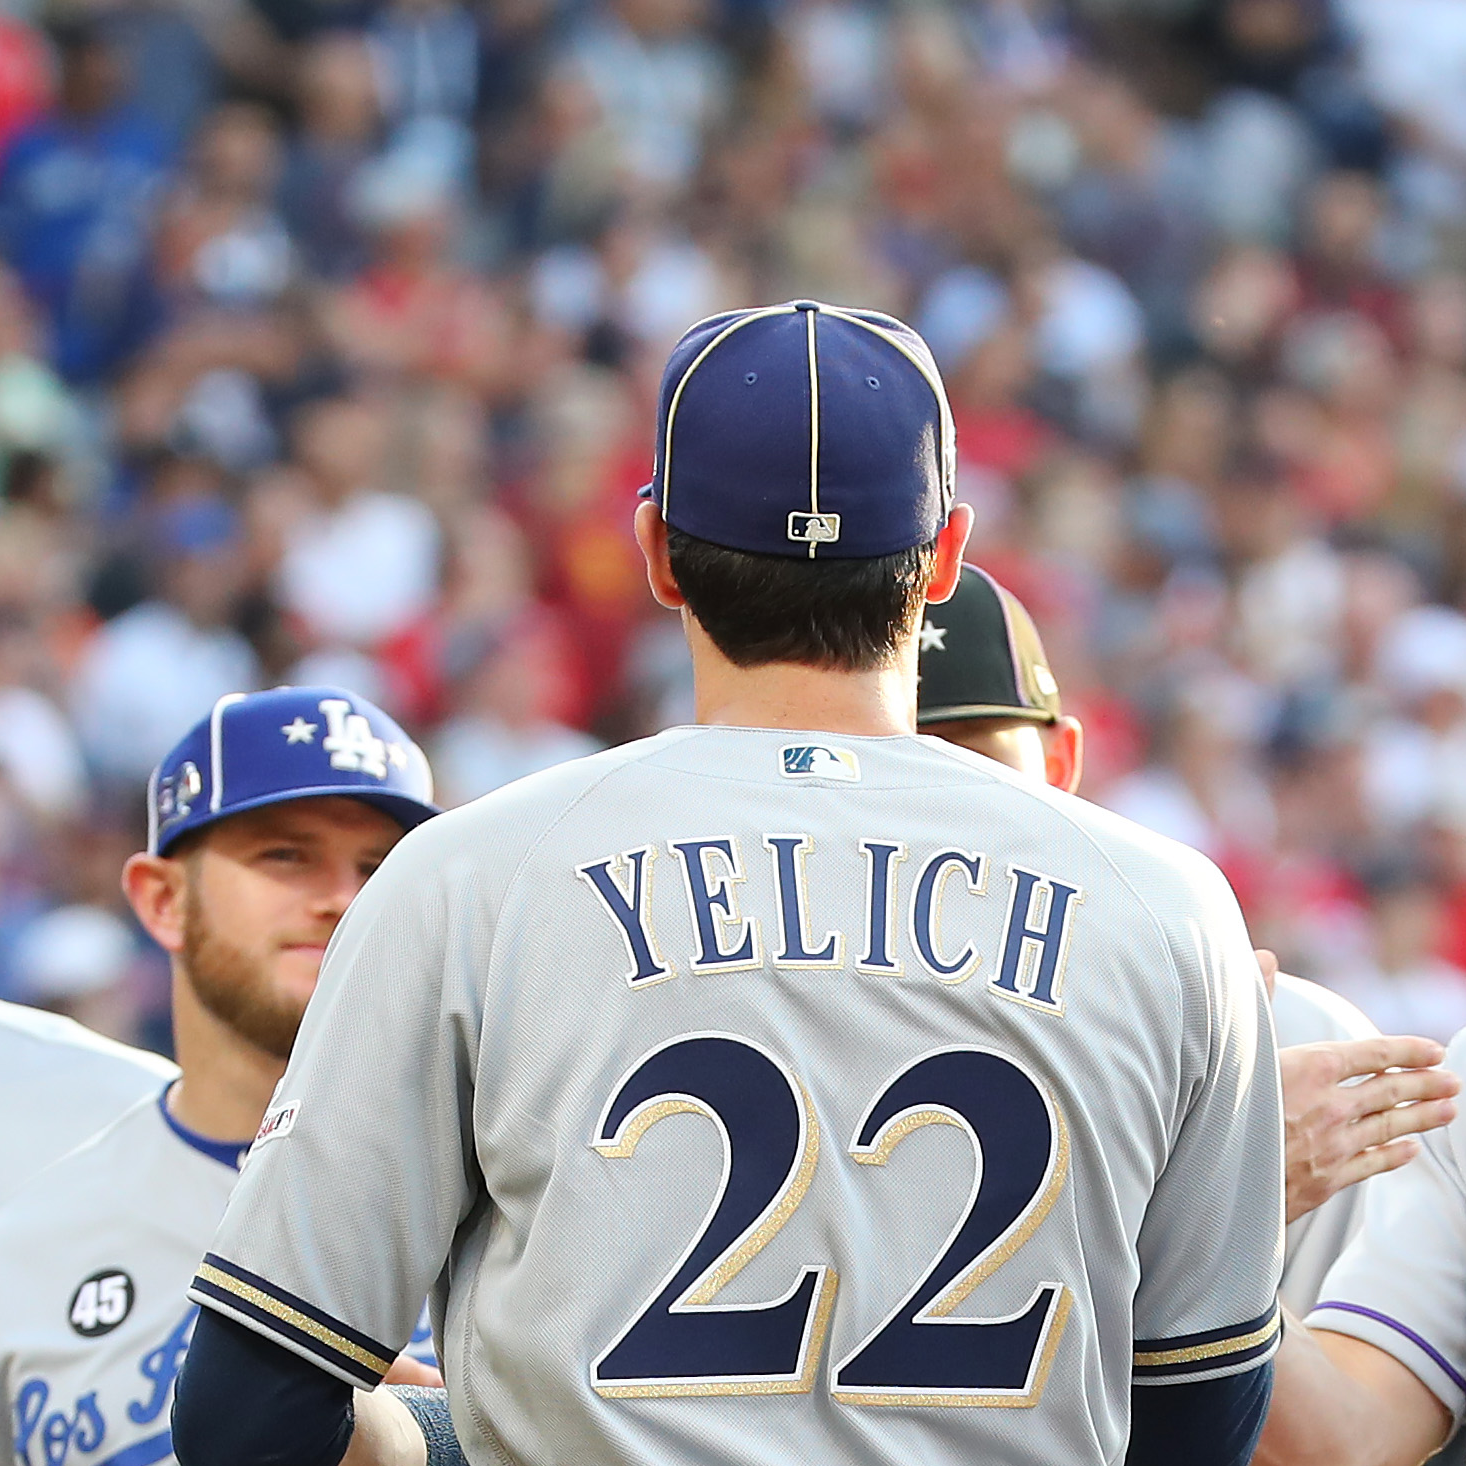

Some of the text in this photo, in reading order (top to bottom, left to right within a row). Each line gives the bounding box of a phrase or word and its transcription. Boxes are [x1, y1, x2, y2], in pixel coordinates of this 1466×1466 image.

[318, 699, 388, 780] LA
[574, 833, 1086, 1018] YELICH
[589, 1029, 1075, 1409] 22
[70, 1274, 129, 1331] 45
